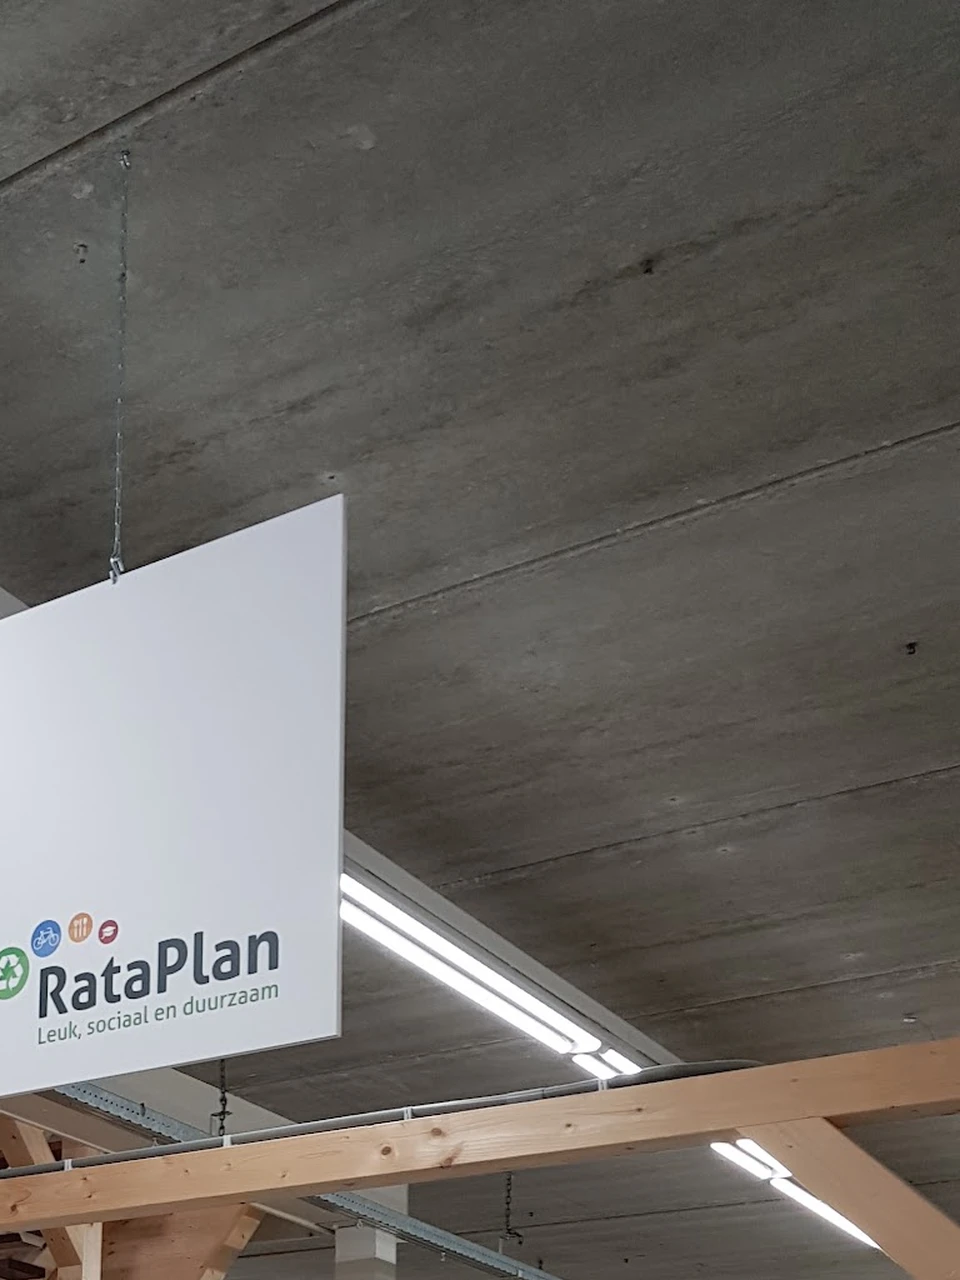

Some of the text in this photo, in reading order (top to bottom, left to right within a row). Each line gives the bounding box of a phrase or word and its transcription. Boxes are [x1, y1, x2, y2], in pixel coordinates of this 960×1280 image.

[38, 929, 280, 1019] RataPlan
[38, 983, 279, 1045] Leuk, sociaal en duurzaam
